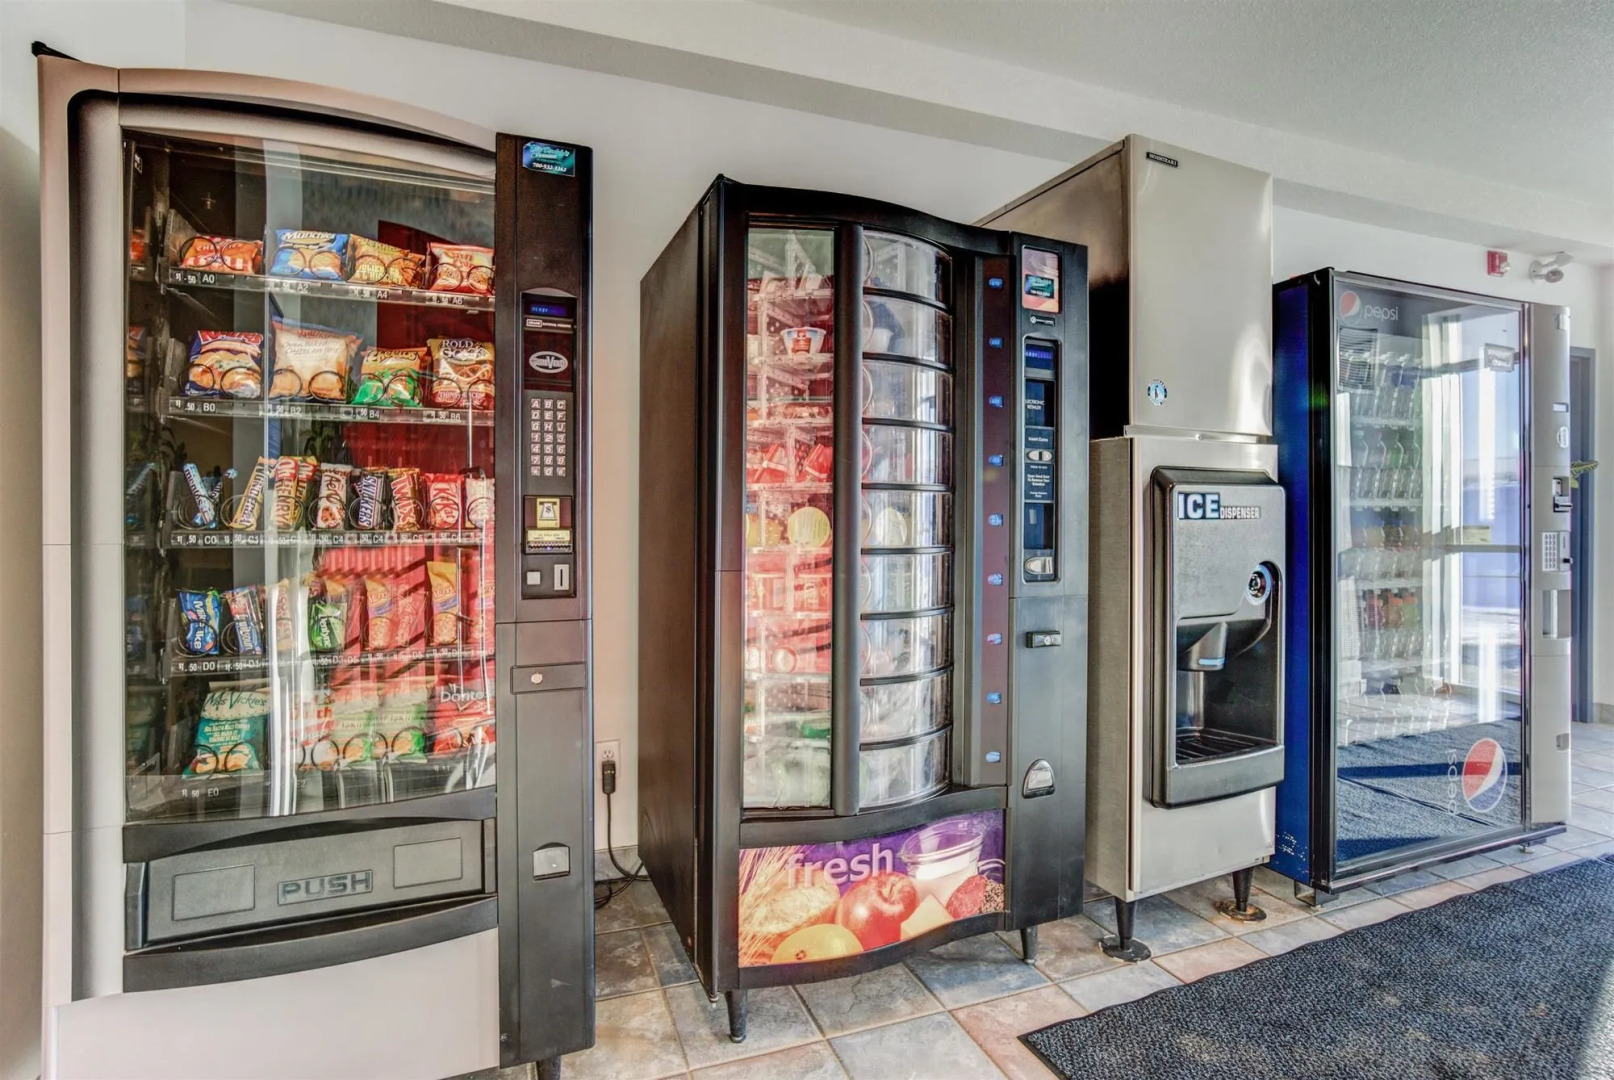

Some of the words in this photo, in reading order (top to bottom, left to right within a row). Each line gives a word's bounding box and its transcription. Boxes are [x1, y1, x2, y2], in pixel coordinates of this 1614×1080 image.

[1363, 304, 1399, 321] pepsi
[442, 339, 474, 349] ROLD
[359, 476, 377, 526] SNICKERS
[1178, 494, 1219, 519] ICE
[1220, 507, 1260, 519] DISPENSER
[1445, 749, 1460, 815] pepsi
[786, 843, 894, 889] fresh
[280, 872, 371, 901] PUSH
